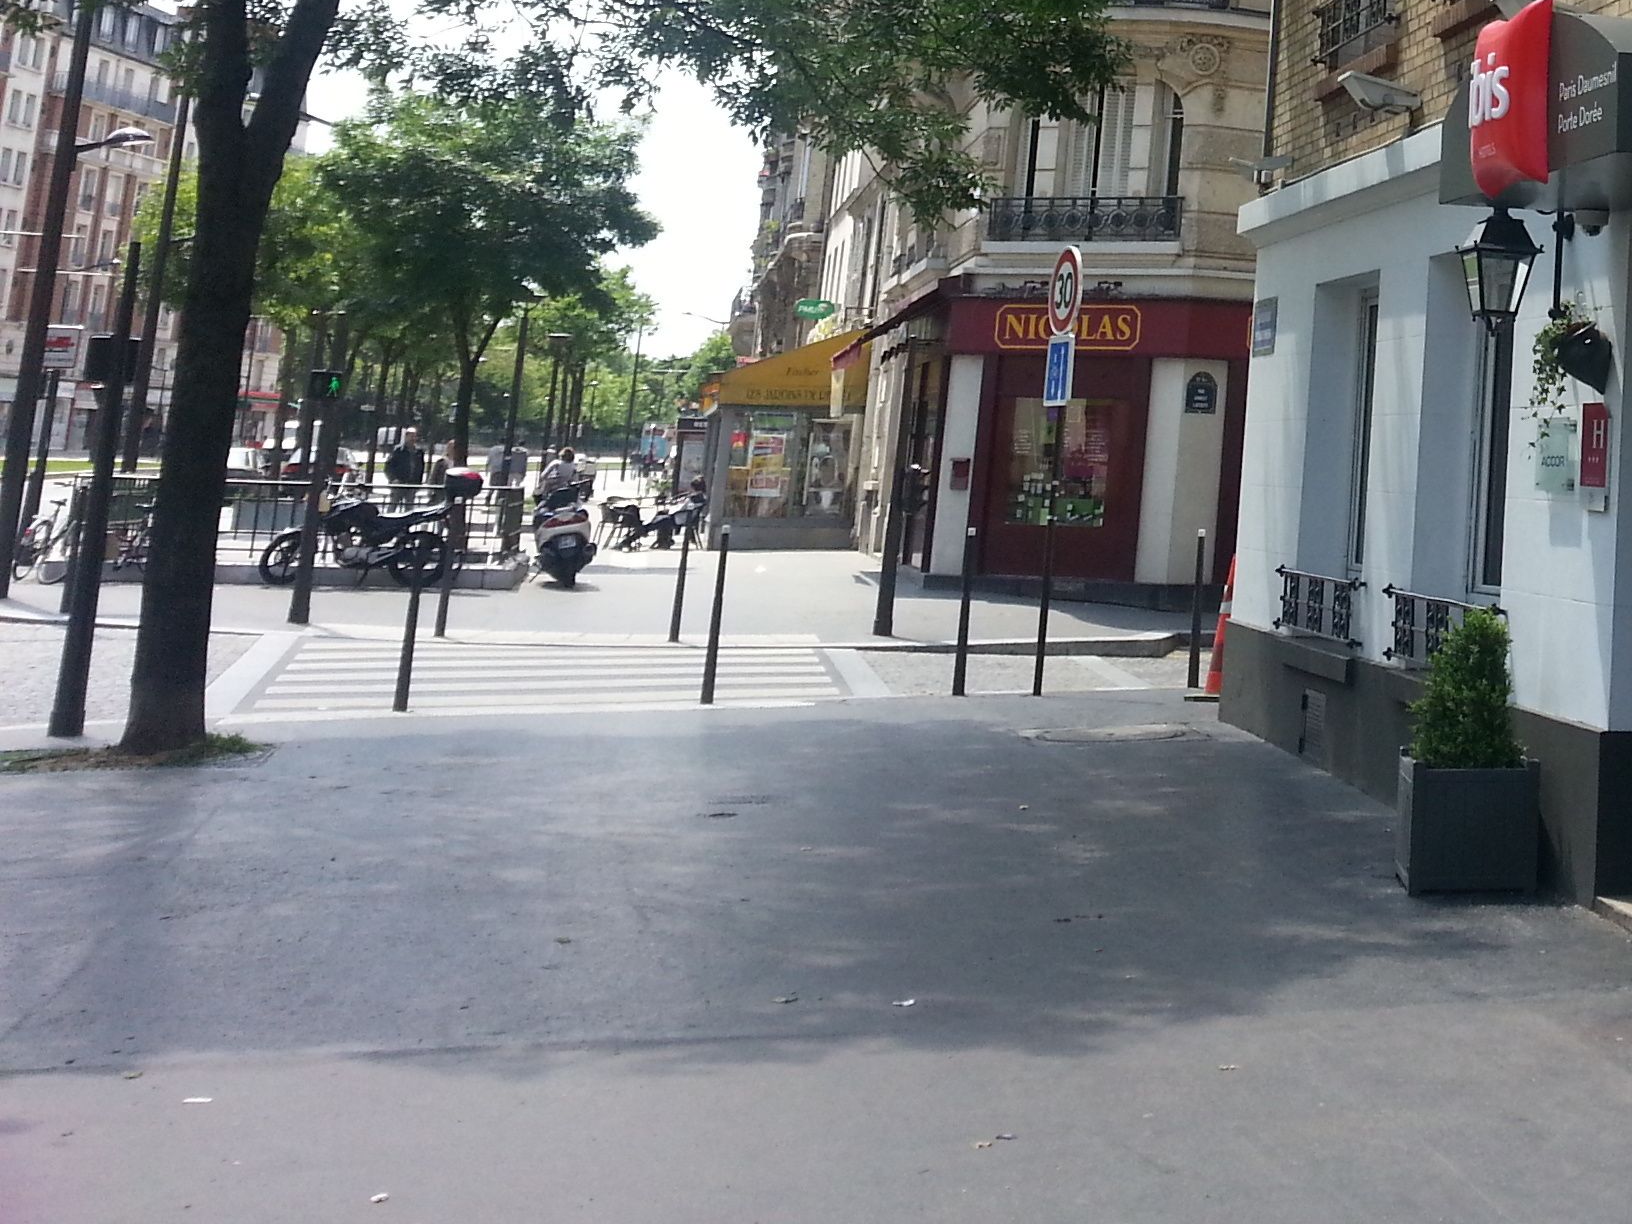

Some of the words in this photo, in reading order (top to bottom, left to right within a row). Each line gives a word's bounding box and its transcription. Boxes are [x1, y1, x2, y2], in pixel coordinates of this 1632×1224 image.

[1468, 51, 1510, 129] ibis
[1559, 80, 1577, 101] Paris
[1577, 61, 1617, 96] Daumesnil
[1557, 111, 1578, 134] Porte
[1579, 101, 1603, 127] Dorée
[1054, 272, 1073, 309] 30
[1004, 313, 1132, 341] NICLAS
[1592, 419, 1605, 449] H
[1541, 455, 1566, 468] ACCOR
